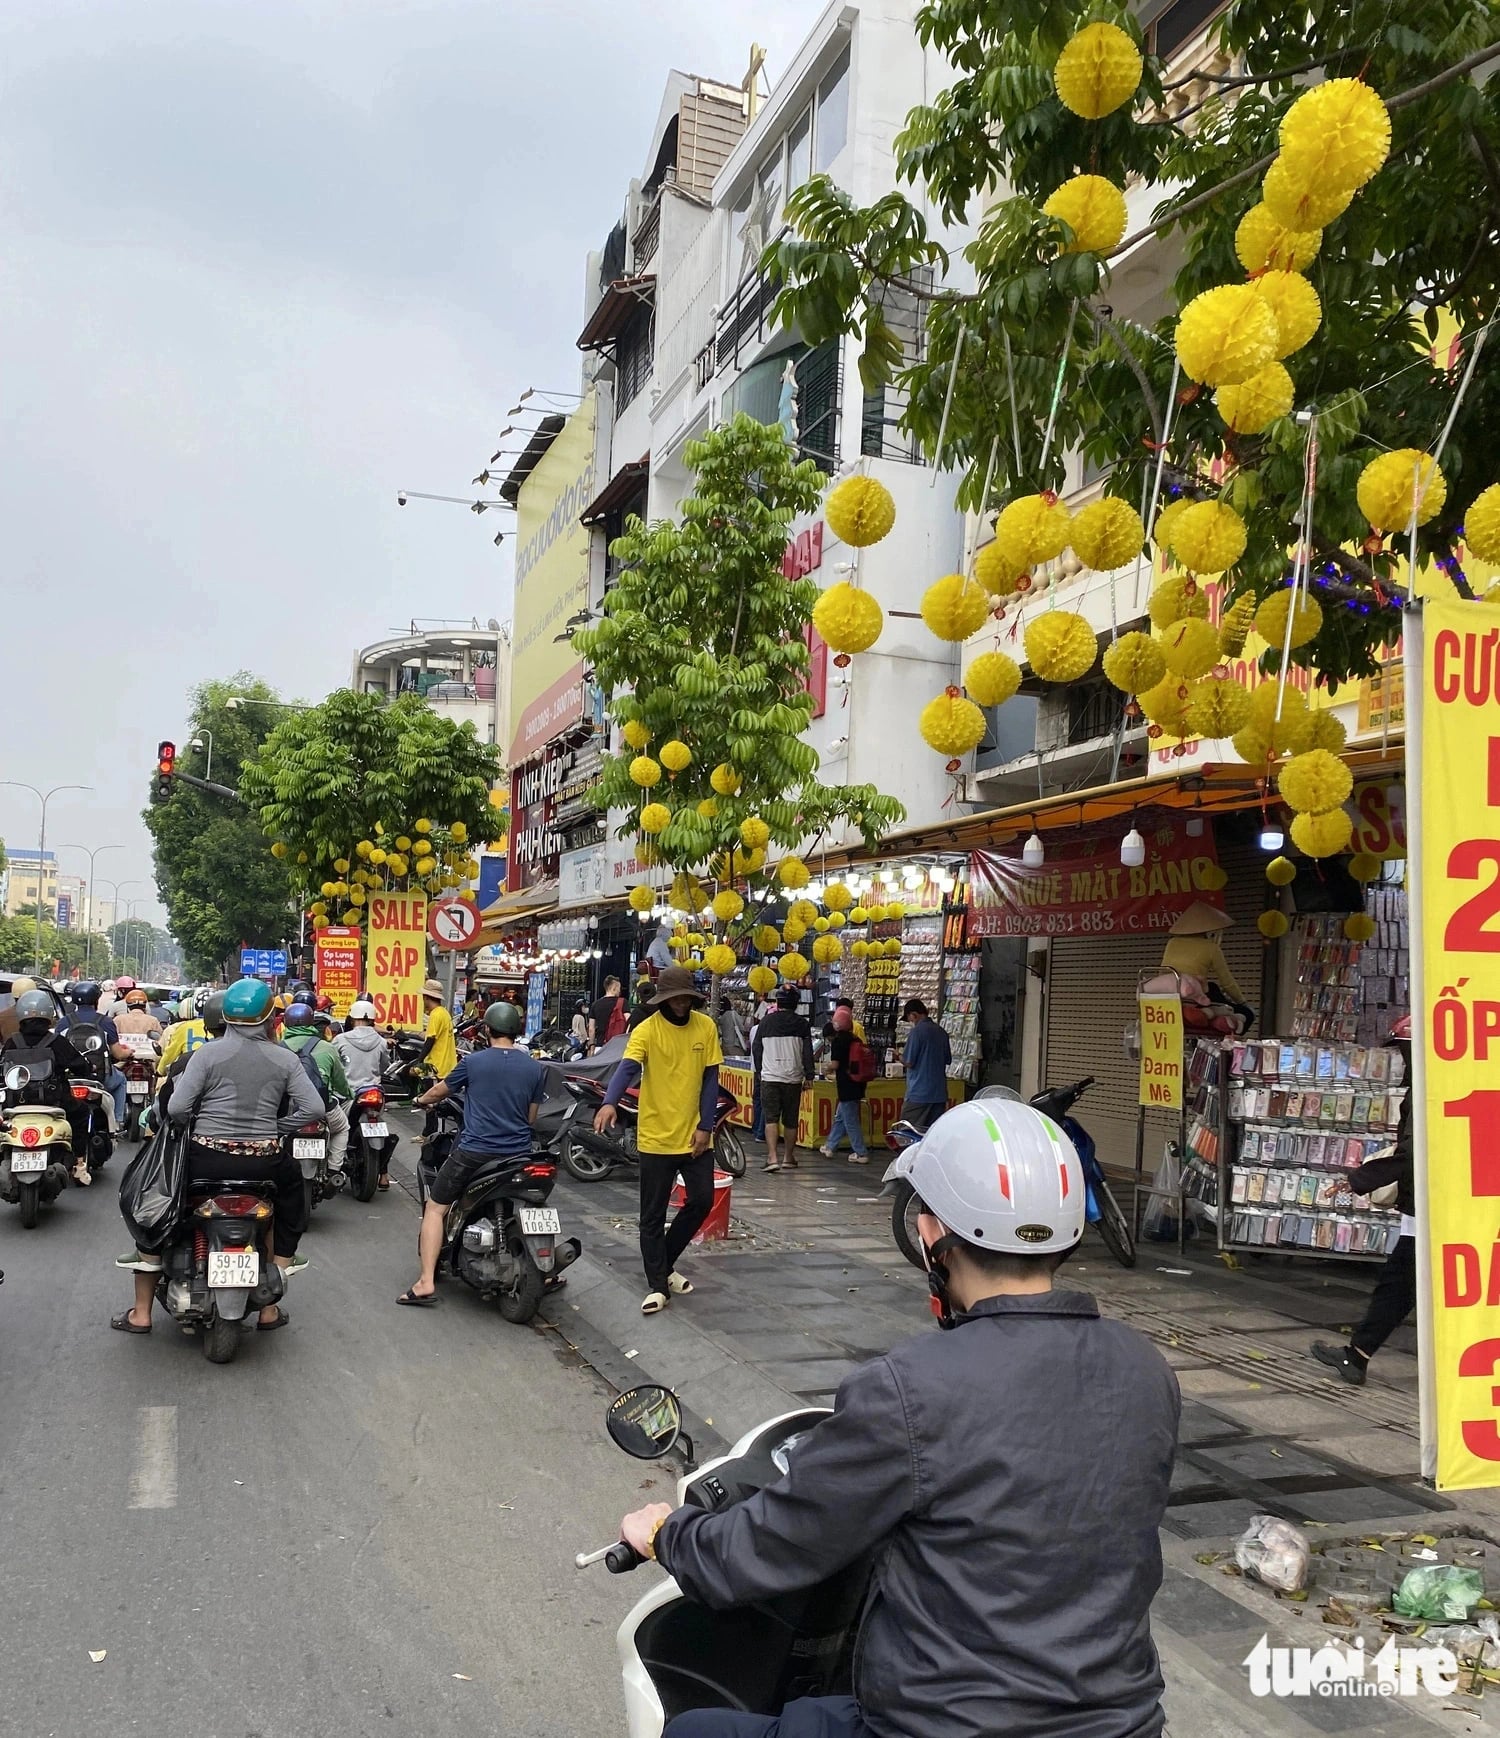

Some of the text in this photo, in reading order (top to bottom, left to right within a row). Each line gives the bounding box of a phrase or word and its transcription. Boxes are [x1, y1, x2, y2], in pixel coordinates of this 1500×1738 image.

[1434, 627, 1500, 707] CƯ
[517, 769, 538, 810] LINH
[1012, 869, 1063, 905] THUÊ
[1070, 863, 1124, 908] MẶT
[371, 898, 425, 932] SALE
[1005, 914, 1042, 935] 0903
[1046, 912, 1075, 934] 831
[1081, 910, 1114, 931] 883
[374, 940, 419, 985] SẬP
[1144, 1006, 1175, 1024] Bán
[1153, 1032, 1168, 1050] Vì
[1144, 1057, 1178, 1077] Đam
[718, 1070, 743, 1097] ƯỜNG
[1149, 1083, 1171, 1102] Mê
[216, 1254, 251, 1269] 59-D2
